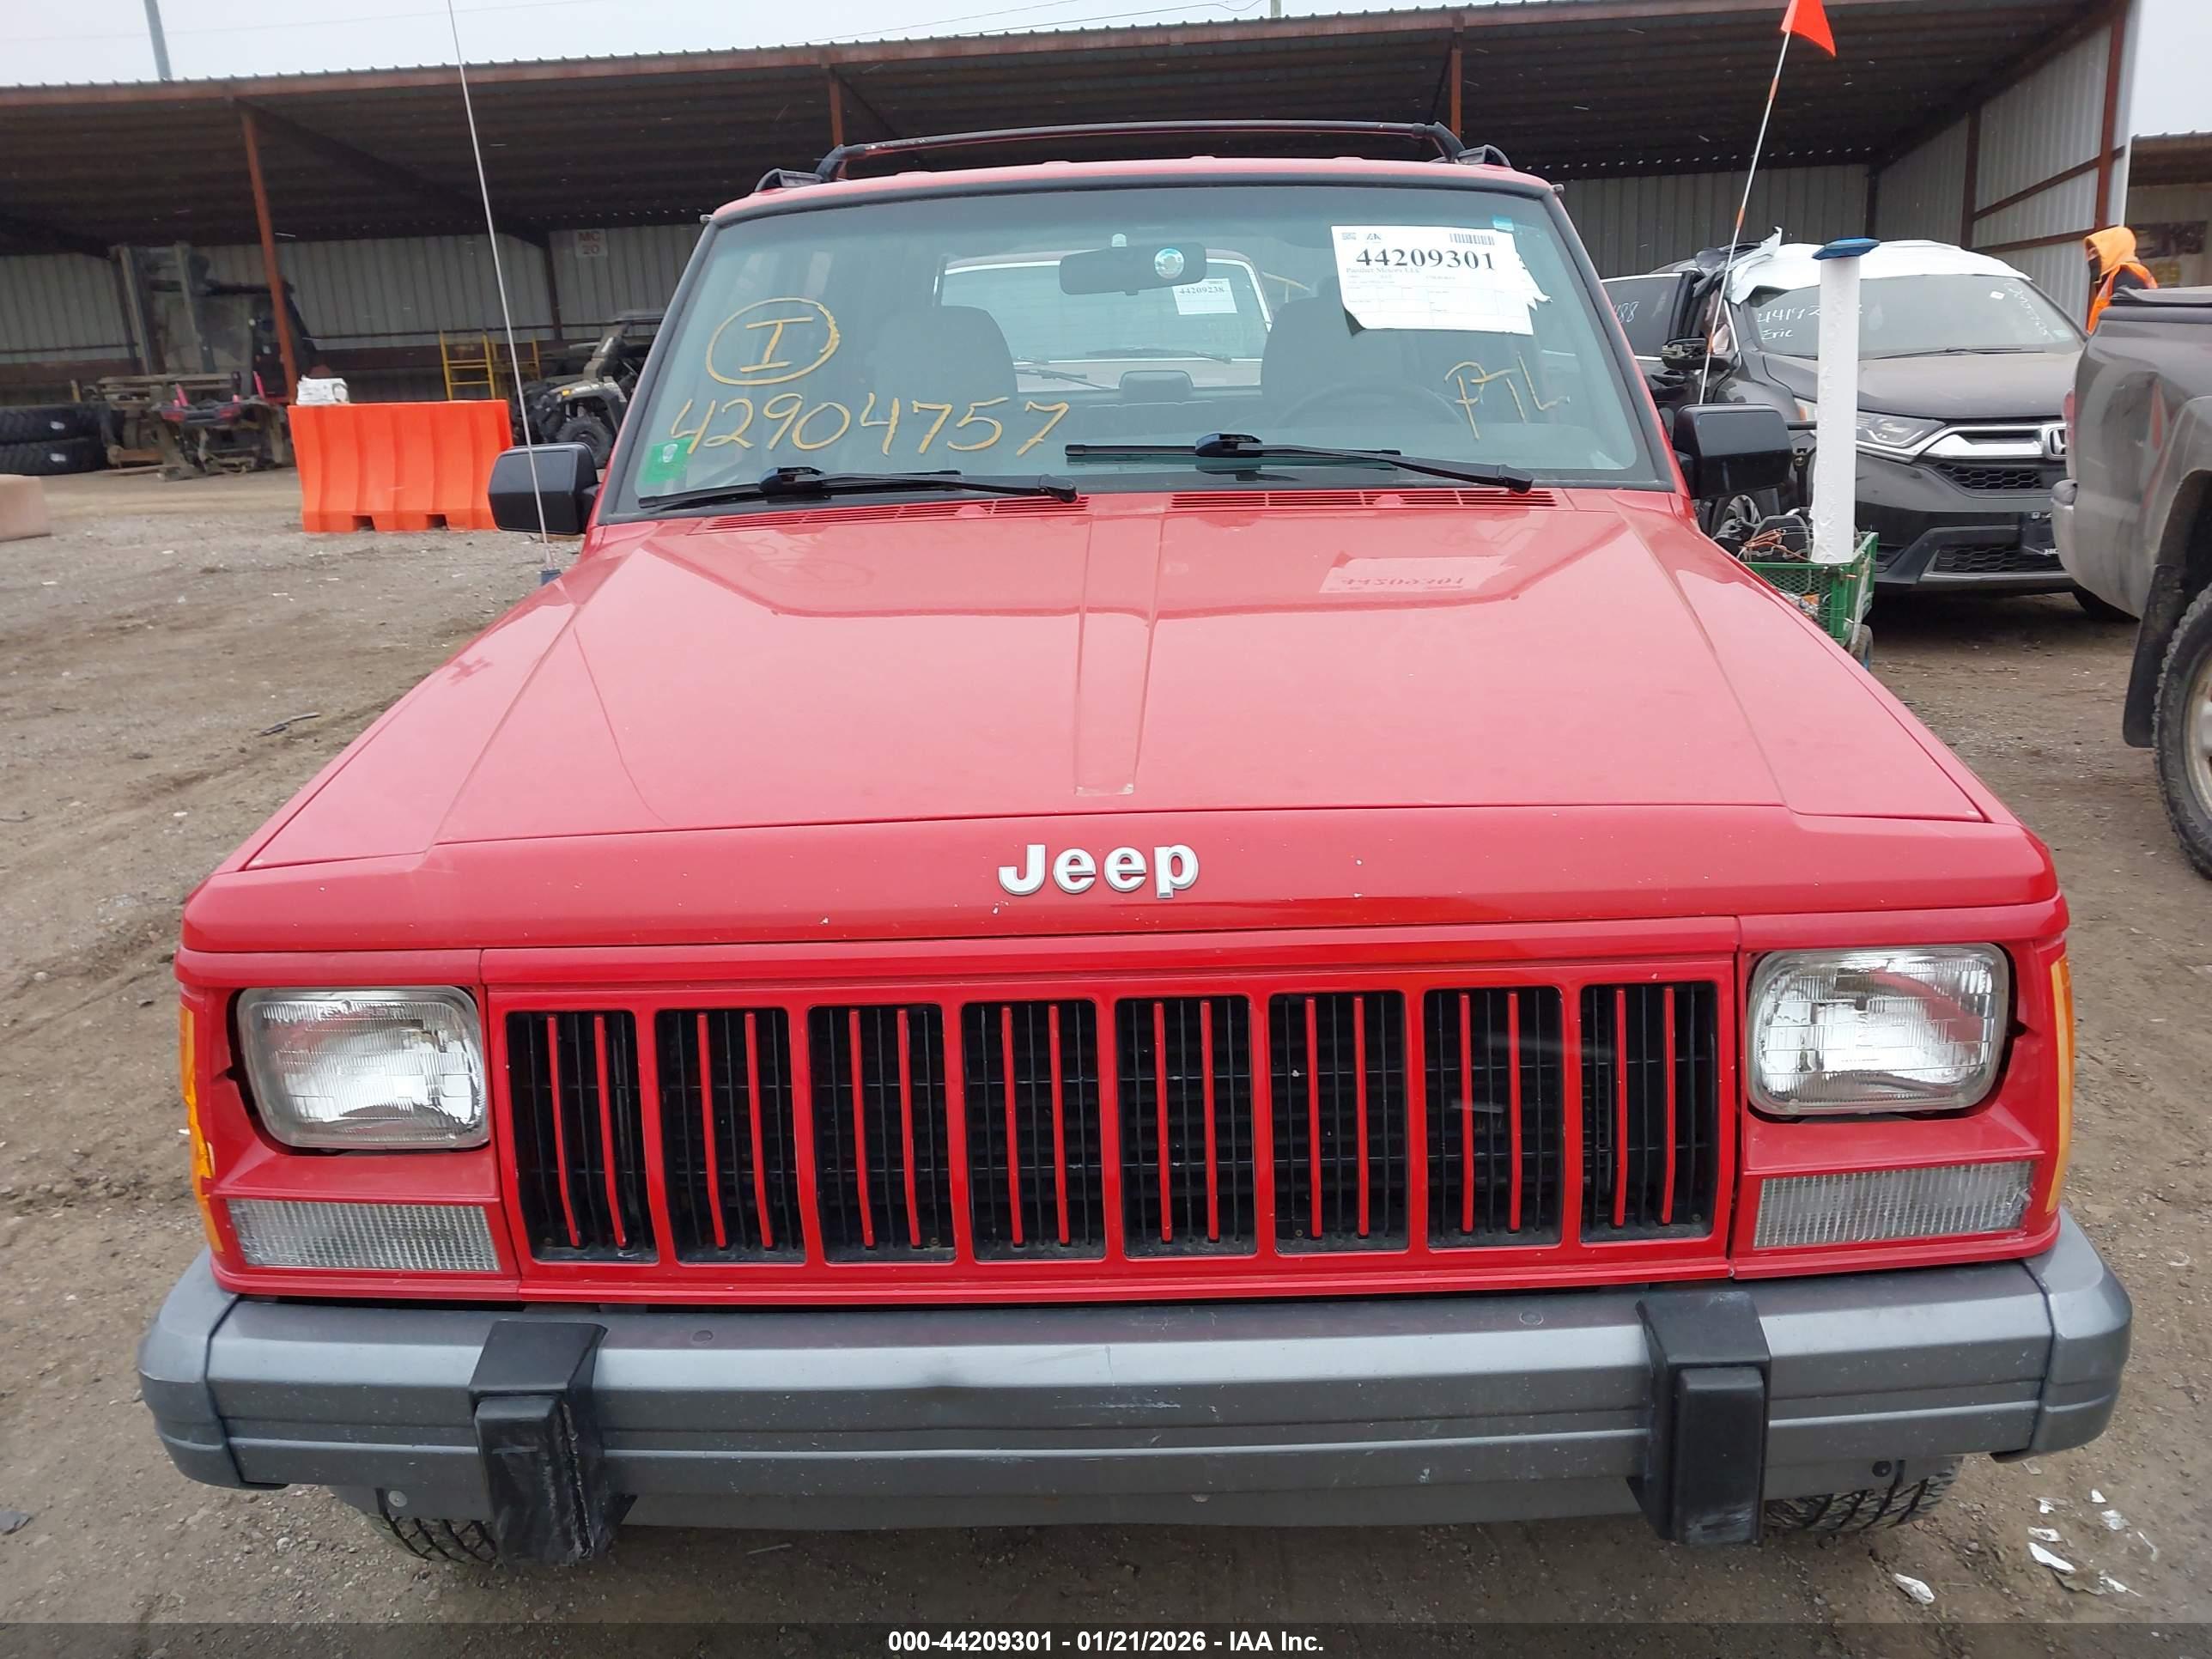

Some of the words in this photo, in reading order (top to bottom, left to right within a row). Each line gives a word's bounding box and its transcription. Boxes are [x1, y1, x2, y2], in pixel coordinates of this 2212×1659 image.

[1356, 248, 1495, 270] 44209301
[1761, 325, 1794, 341] Eric
[670, 392, 1071, 457] 42904757
[998, 843, 1200, 899] Jeep
